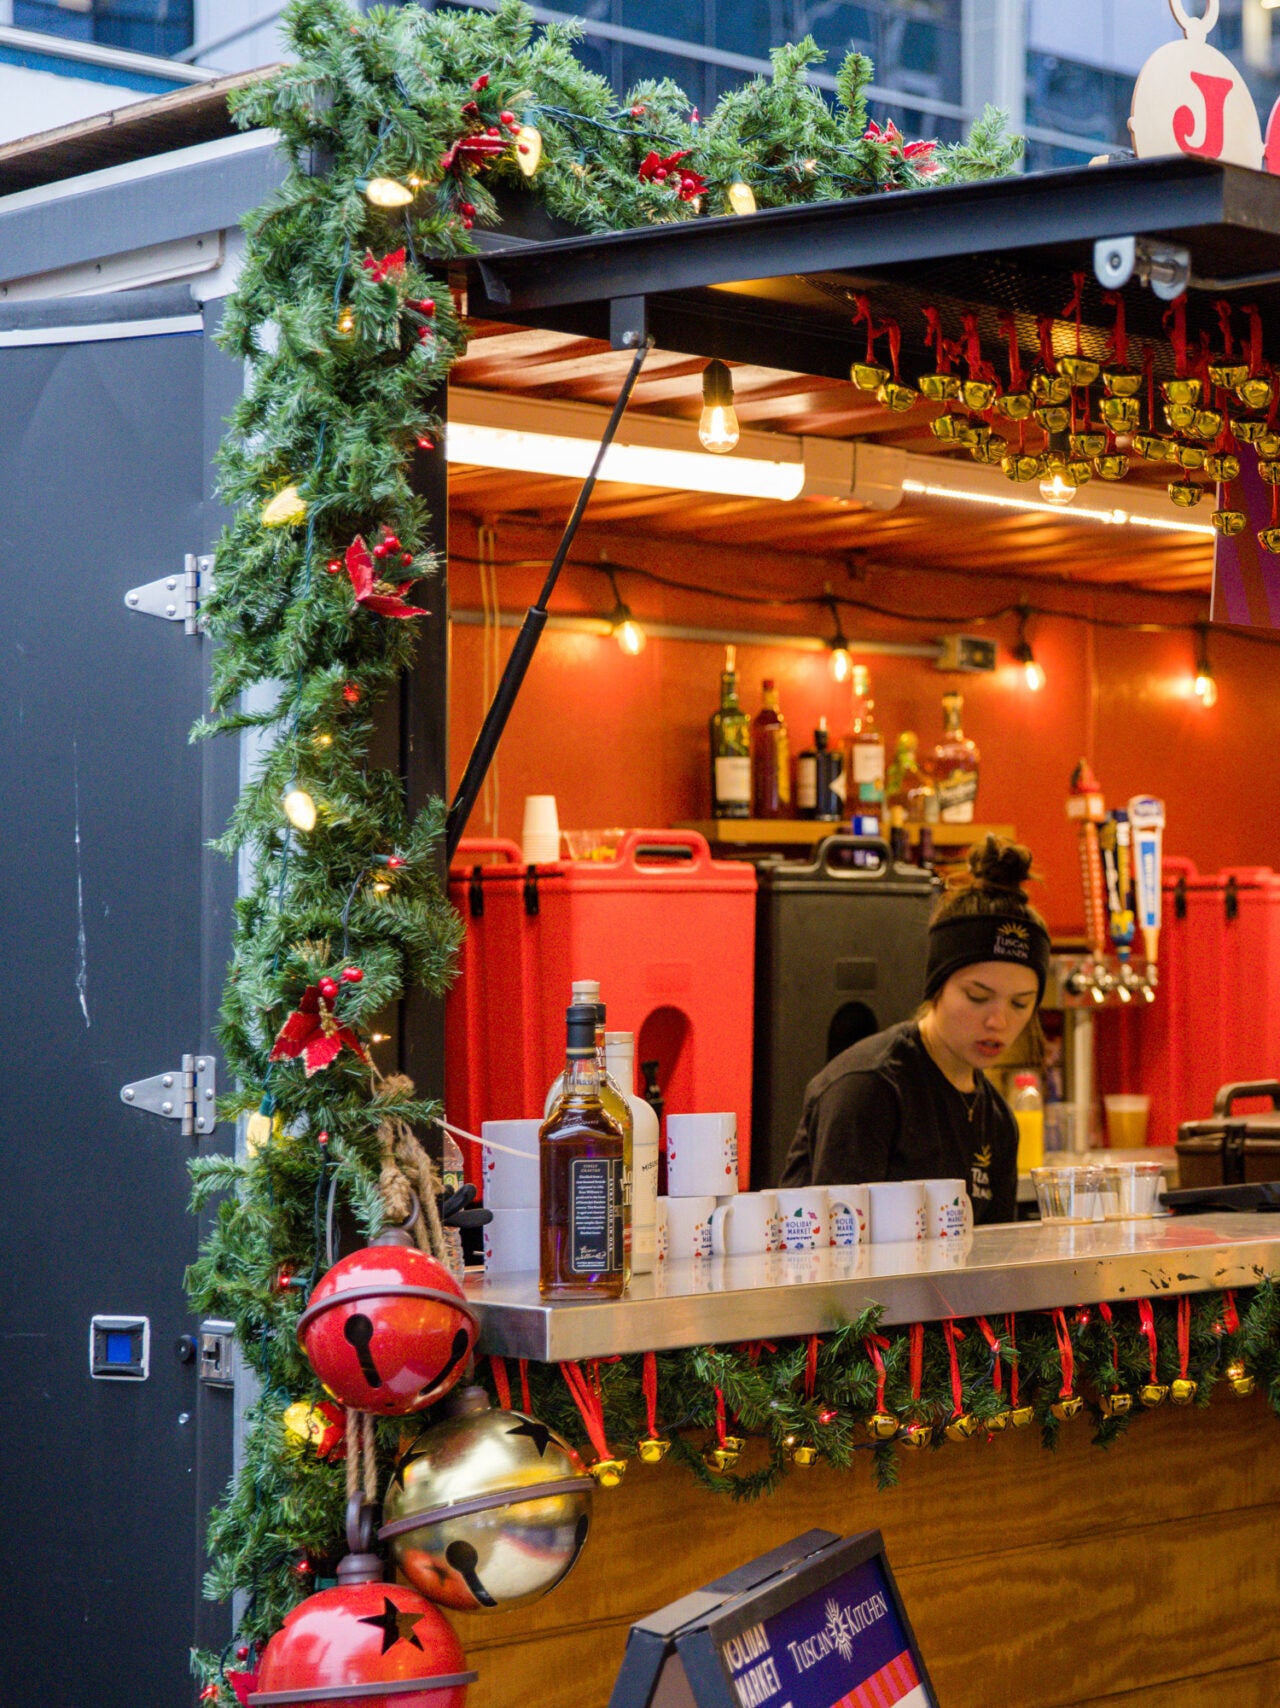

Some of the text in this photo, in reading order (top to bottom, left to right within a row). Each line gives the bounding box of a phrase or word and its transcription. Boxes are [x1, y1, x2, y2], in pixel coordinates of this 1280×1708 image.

[786, 1220, 812, 1228] HOLIDAY
[787, 1591, 888, 1673] TUSCAN KITCHEN
[734, 1656, 782, 1708] MARKET
